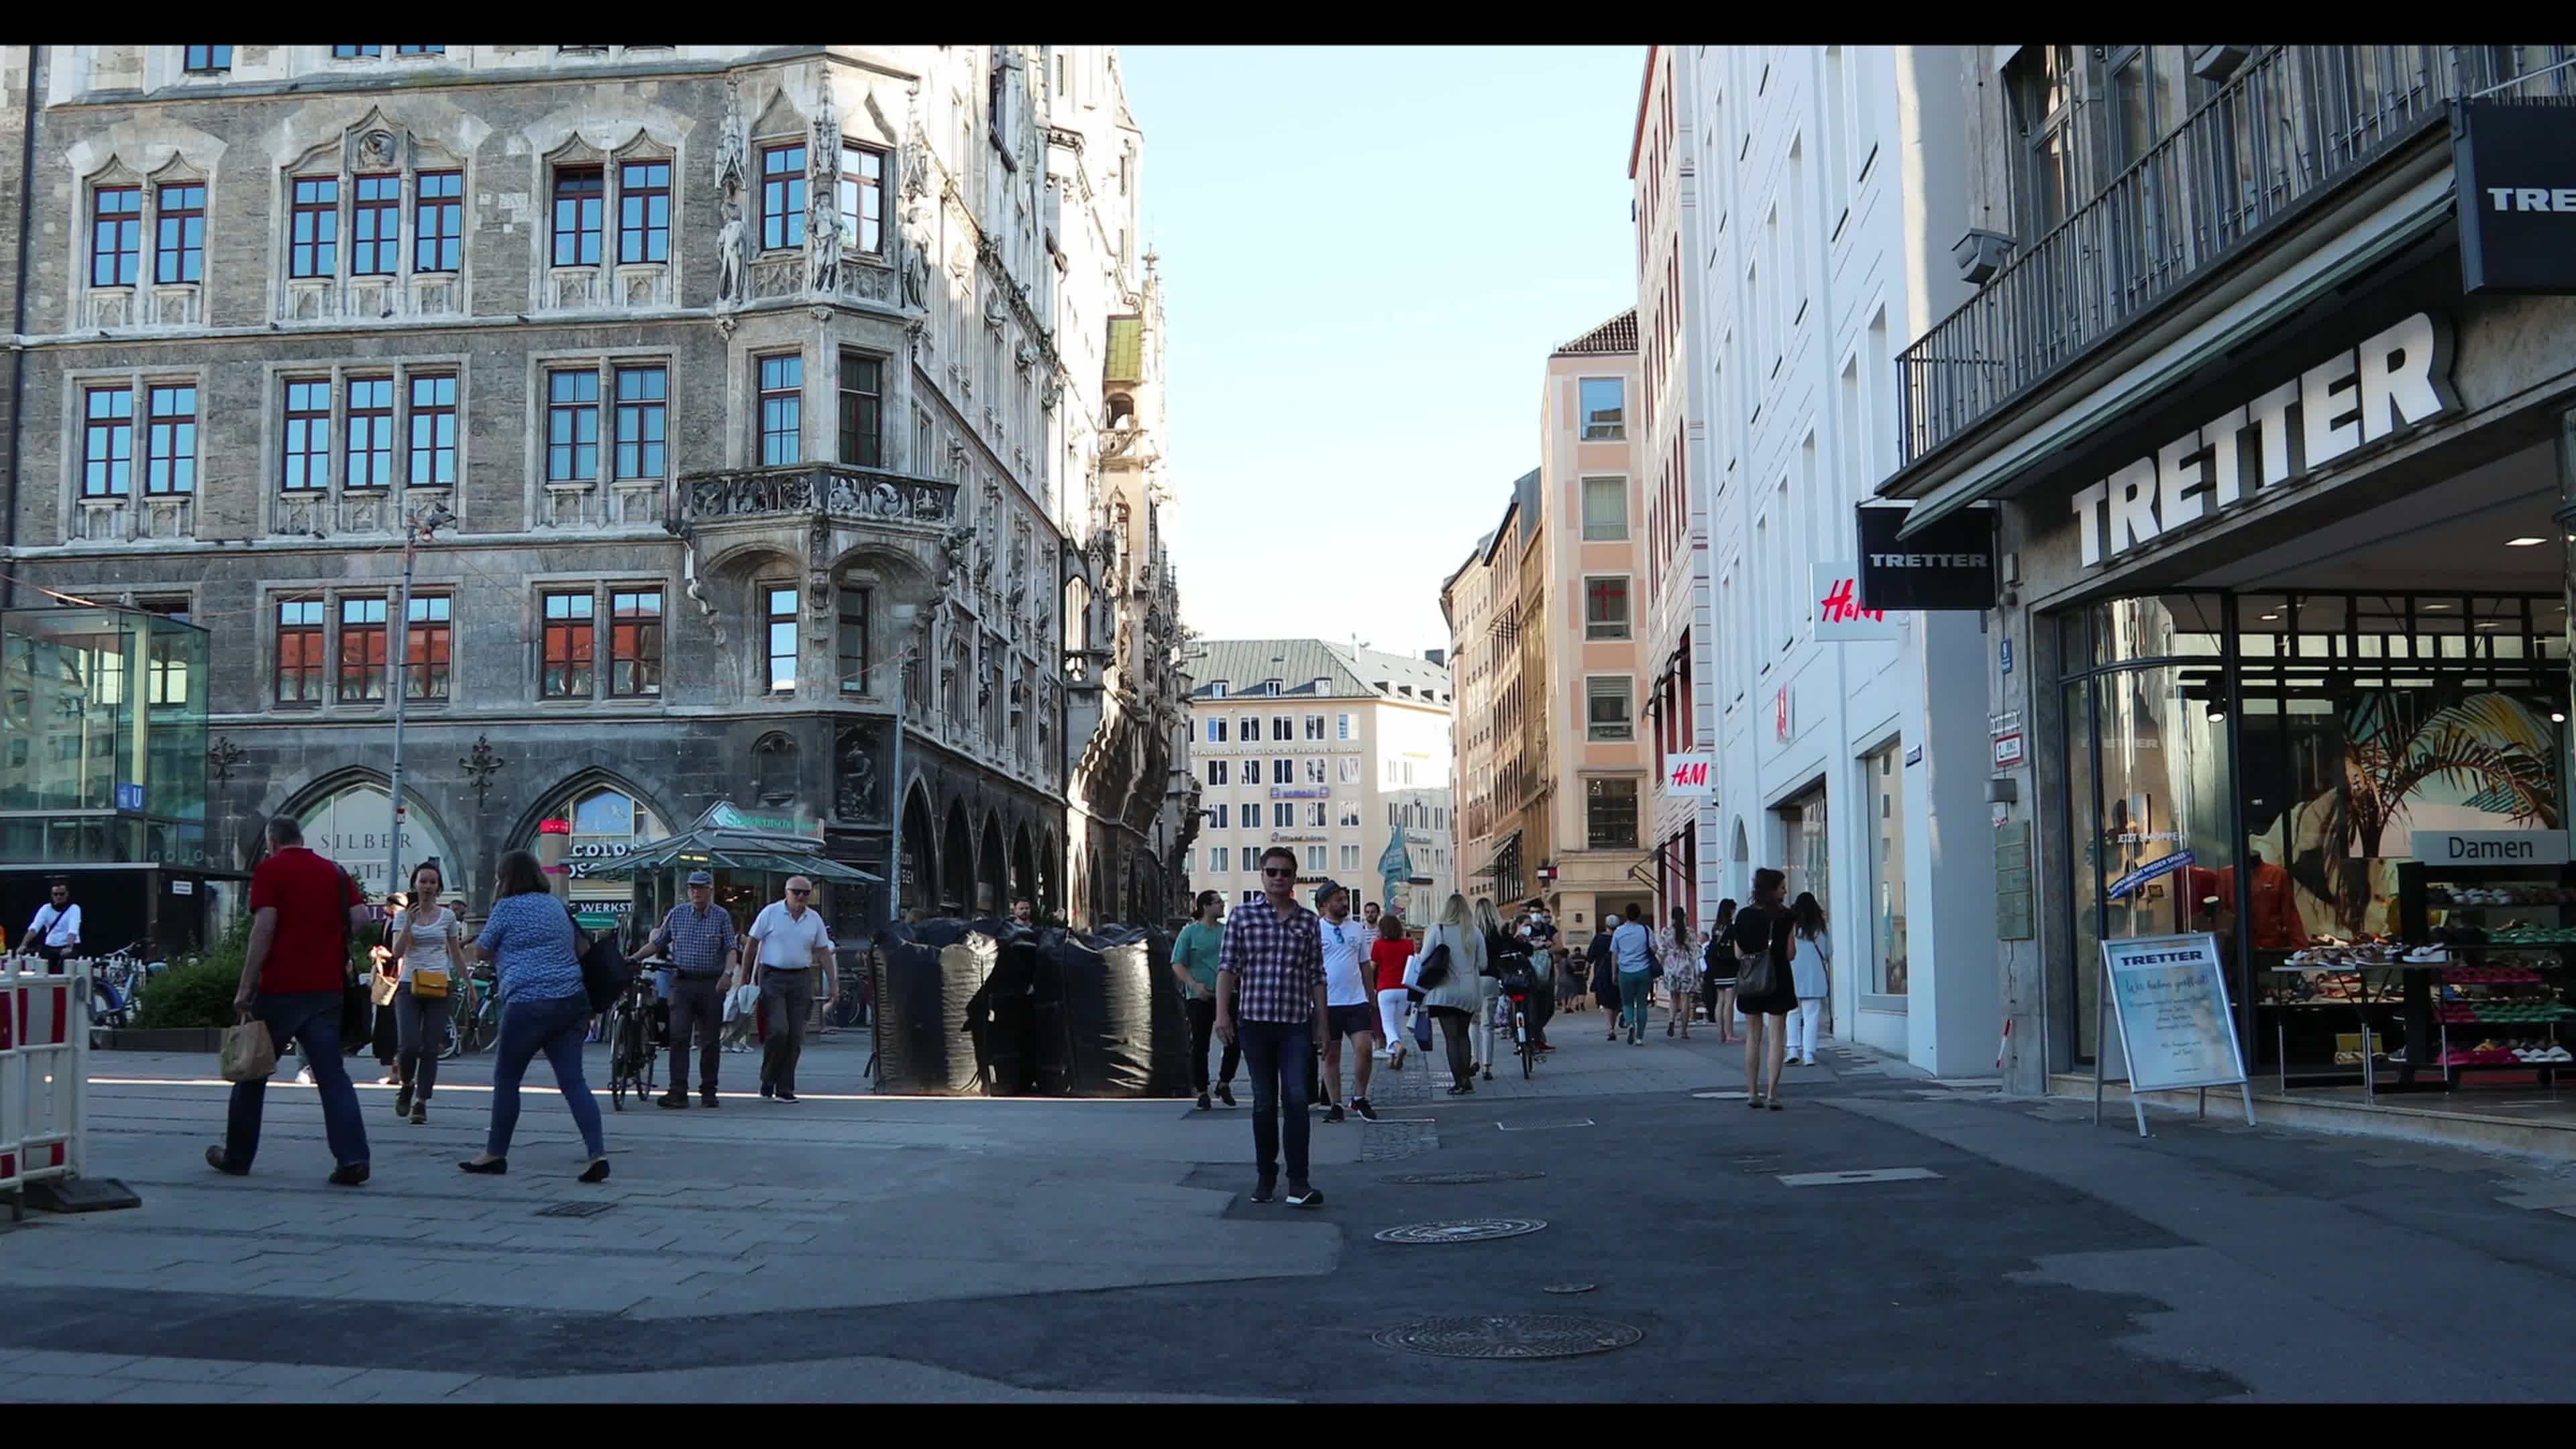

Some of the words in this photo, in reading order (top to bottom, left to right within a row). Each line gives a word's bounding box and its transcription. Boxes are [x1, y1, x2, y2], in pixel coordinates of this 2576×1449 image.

[2072, 312, 2443, 568] TRETTER
[1870, 553, 1988, 568] TRETTER
[1670, 761, 1707, 788] H&M
[320, 834, 411, 849] SILBER
[2448, 837, 2533, 859] Damen
[580, 903, 634, 913] WERKST
[2121, 950, 2204, 967] TRETTER
